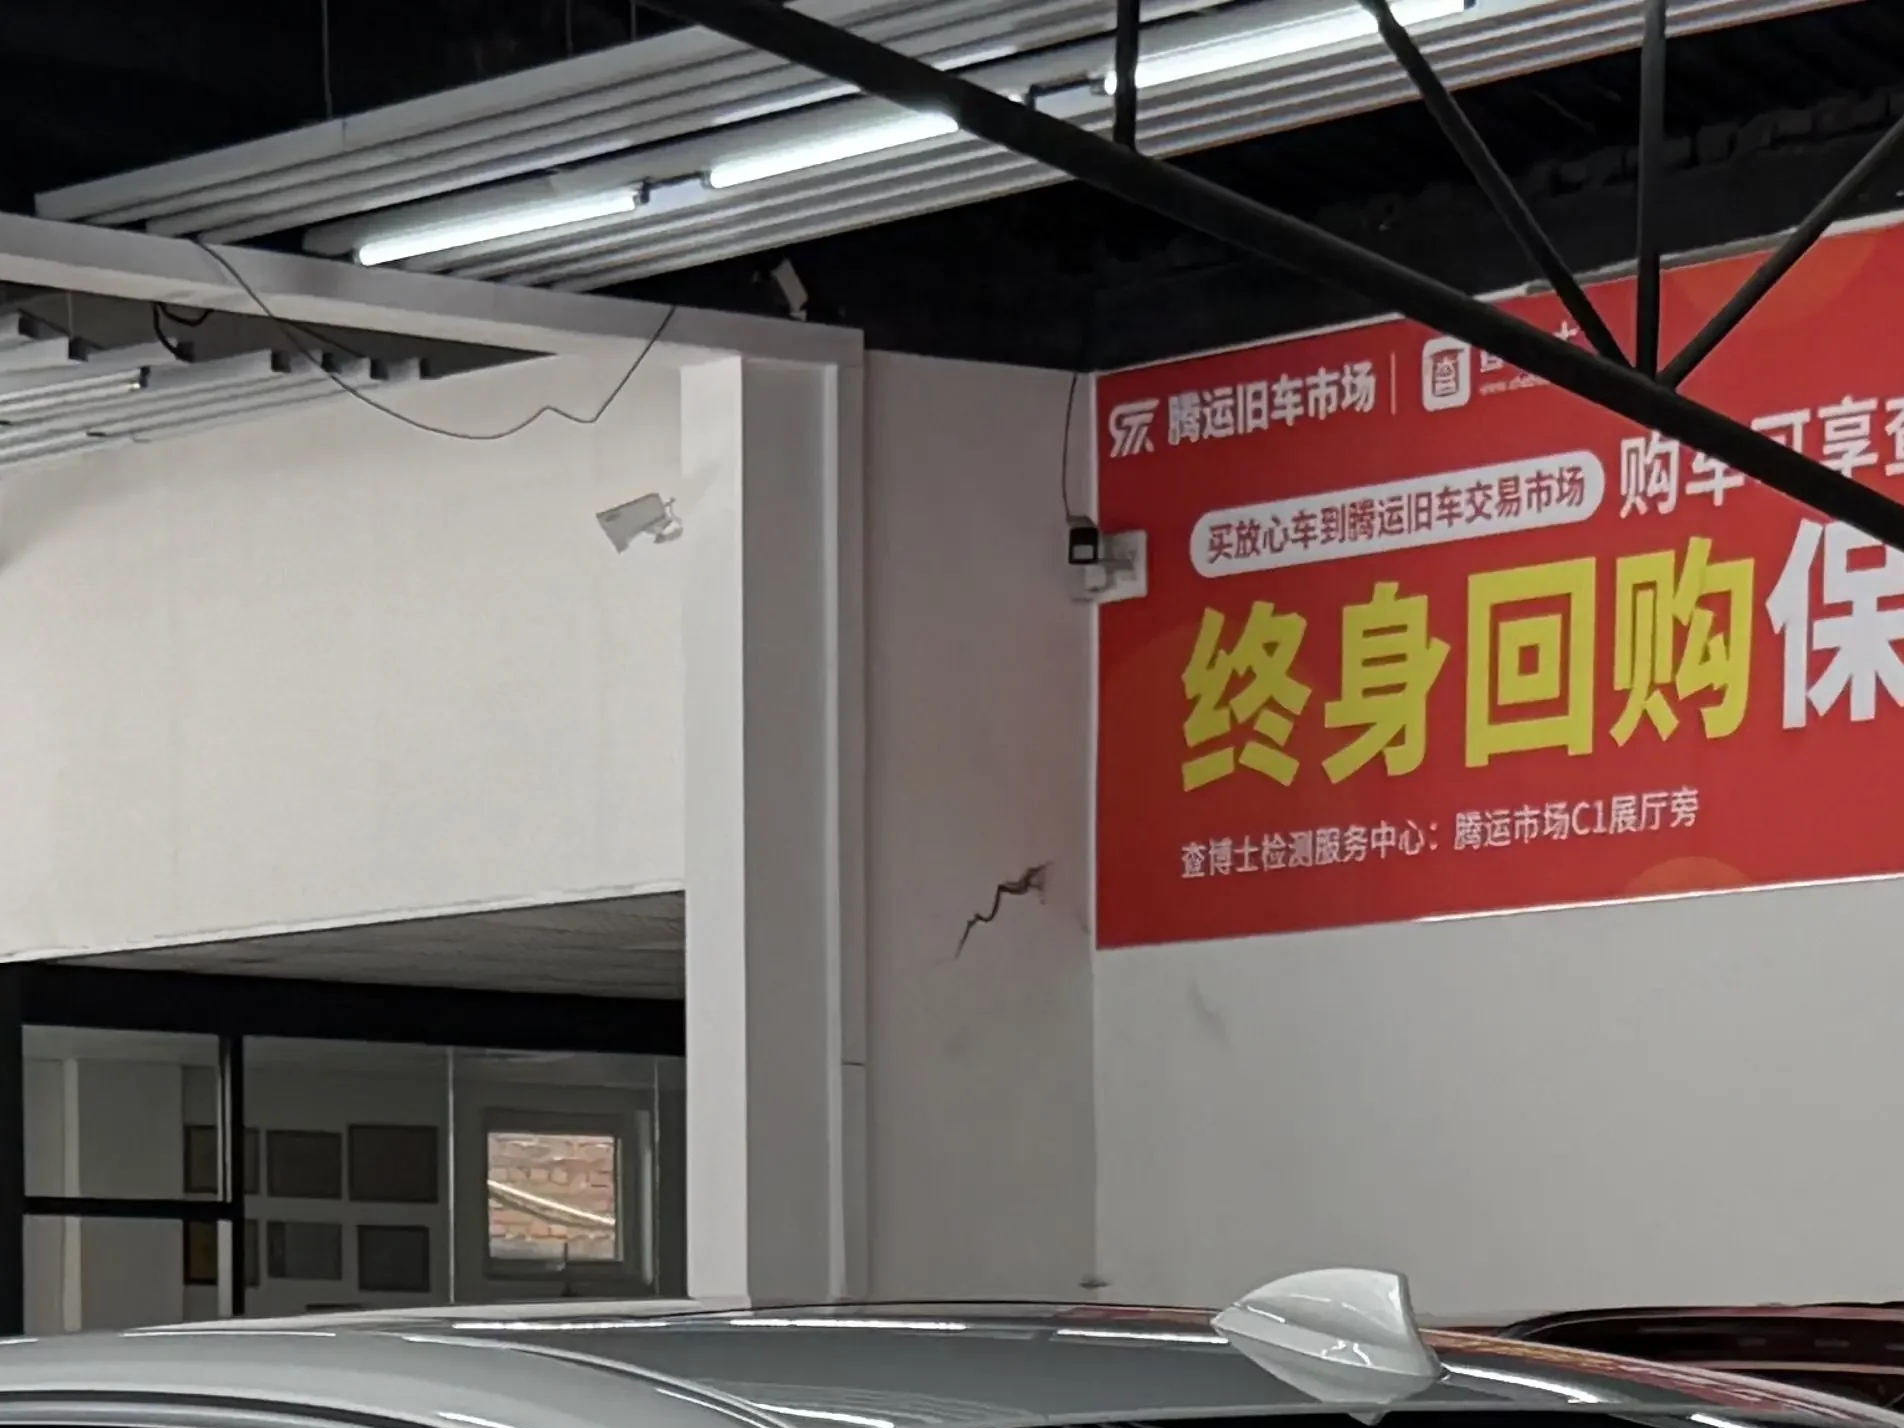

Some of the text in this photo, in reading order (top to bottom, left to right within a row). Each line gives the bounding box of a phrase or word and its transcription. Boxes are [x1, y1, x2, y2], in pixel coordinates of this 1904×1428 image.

[1167, 353, 1376, 446] 腾运旧车市场
[1206, 465, 1585, 565] 买放心车到腾运旧车交易市场
